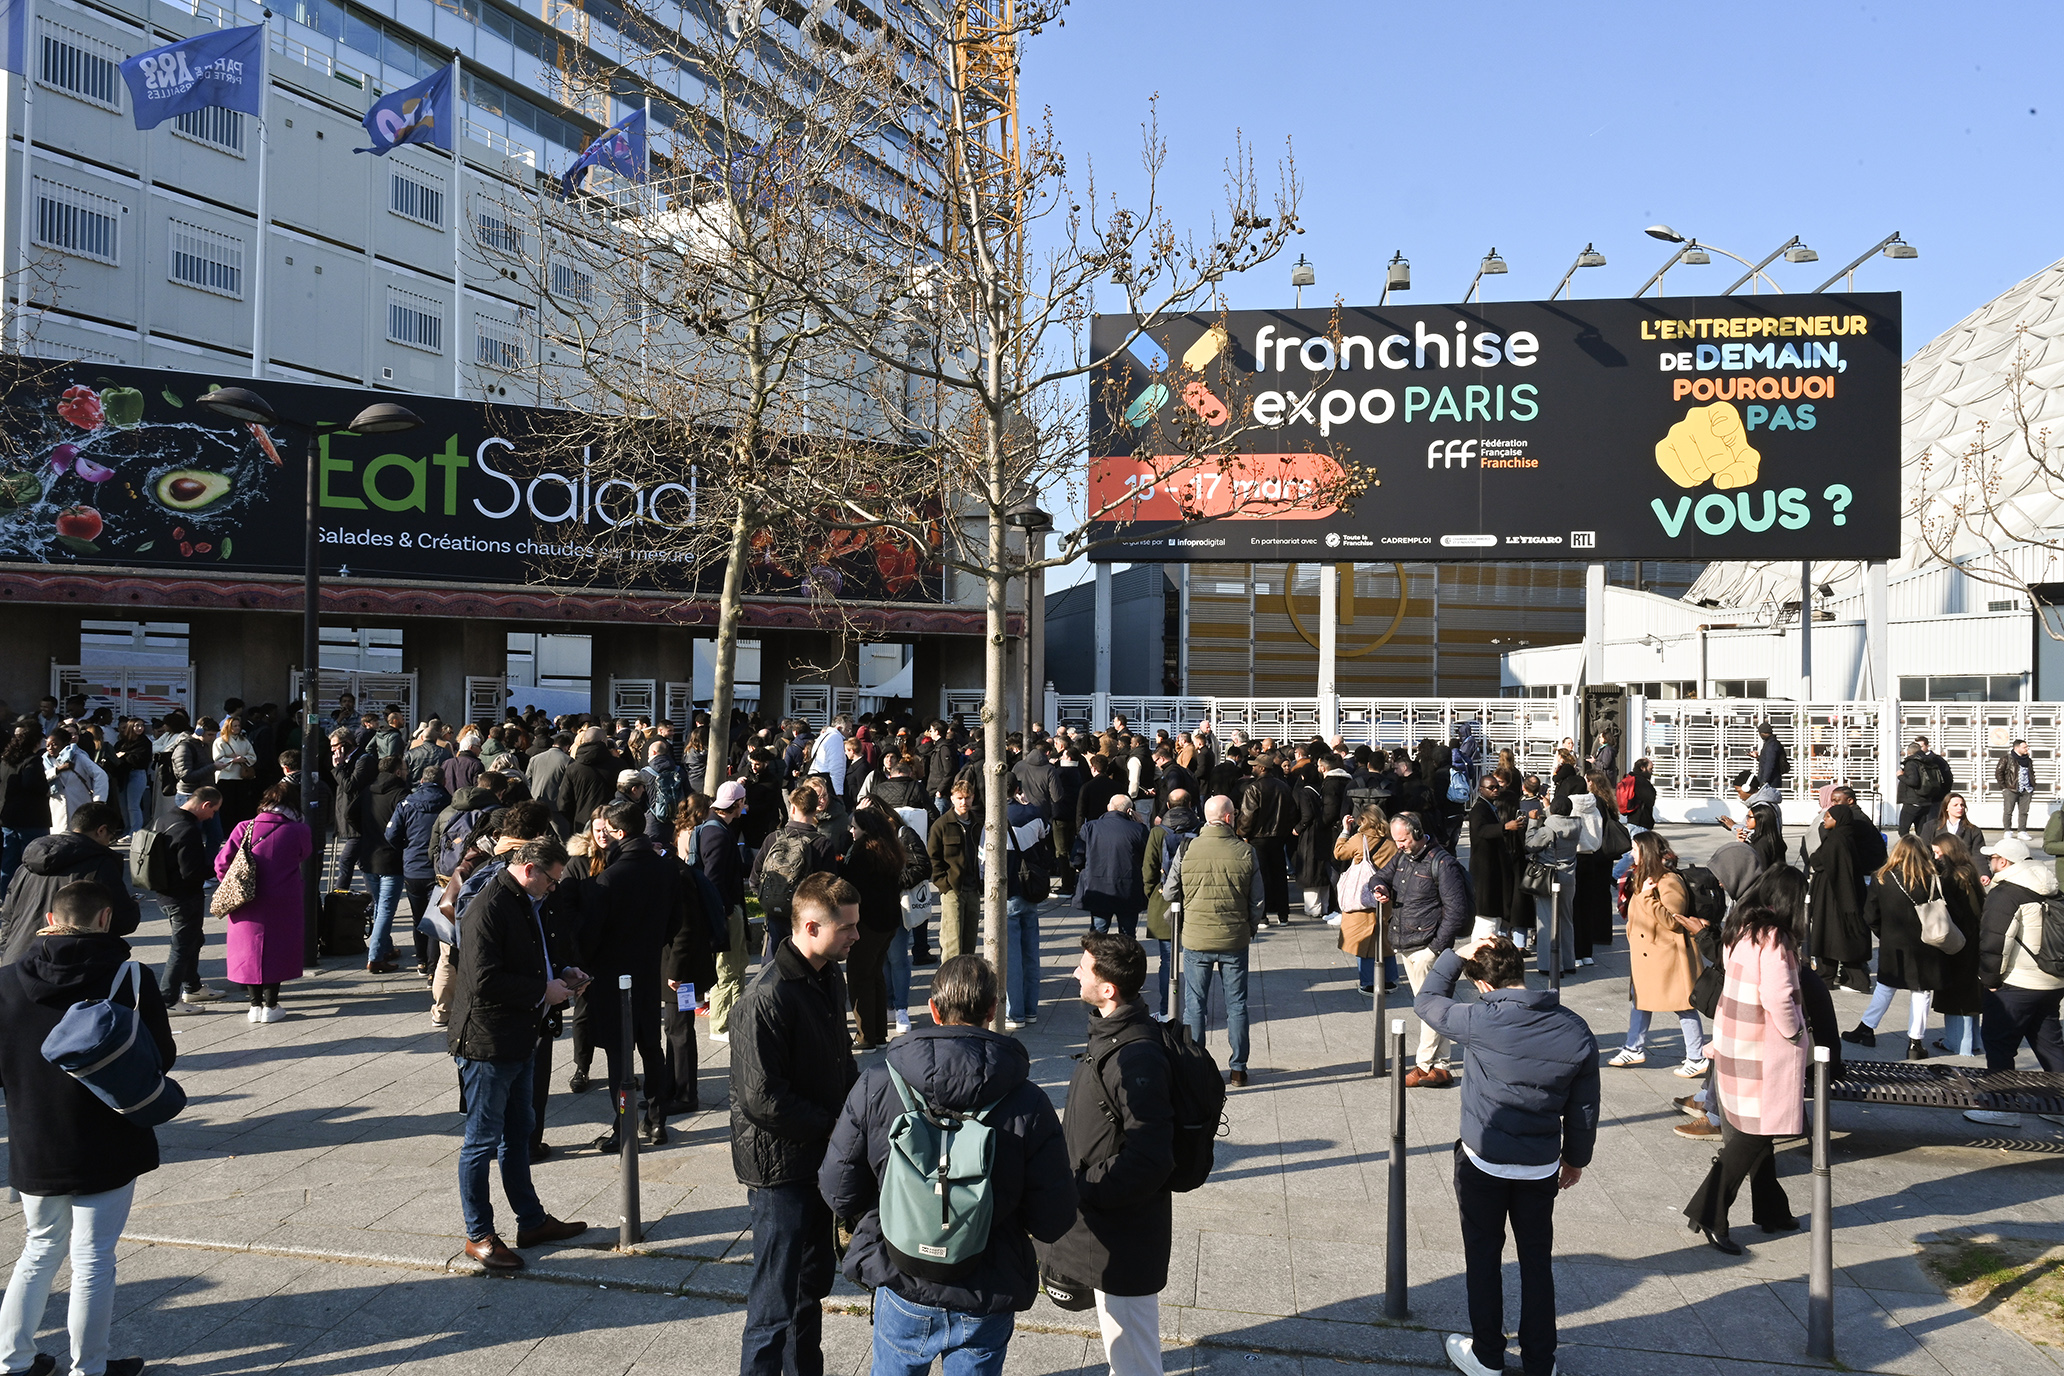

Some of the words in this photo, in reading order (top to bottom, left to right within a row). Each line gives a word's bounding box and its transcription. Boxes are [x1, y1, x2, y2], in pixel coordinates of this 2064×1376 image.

[1640, 315, 1867, 340] L'ENTREPRENEUR
[1255, 320, 1540, 372] franchise
[1660, 352, 1693, 371] DE
[1696, 341, 1848, 373] DEMAIN,
[1673, 375, 1835, 401] POURQUOI
[1253, 388, 1396, 437] expo
[1404, 383, 1539, 423] PARIS
[1746, 404, 1817, 431] PAS
[1480, 439, 1528, 447] Fédération
[1480, 448, 1523, 458] Française
[1480, 457, 1539, 469] Franchise
[1188, 473, 1223, 500] 17
[1232, 478, 1313, 499] mars
[1650, 487, 1811, 538] VOUS
[1823, 483, 1853, 526] ?
[318, 526, 394, 547] Salades
[399, 532, 413, 548] &
[418, 533, 511, 553] Créations
[516, 538, 594, 558] chaudes
[630, 549, 695, 562] mesure
[1177, 538, 1226, 547] infoprodigital
[1261, 538, 1300, 546] partenariat
[1505, 536, 1520, 544] LE
[1520, 535, 1563, 544] FIGARO
[1573, 533, 1593, 546] RTL
